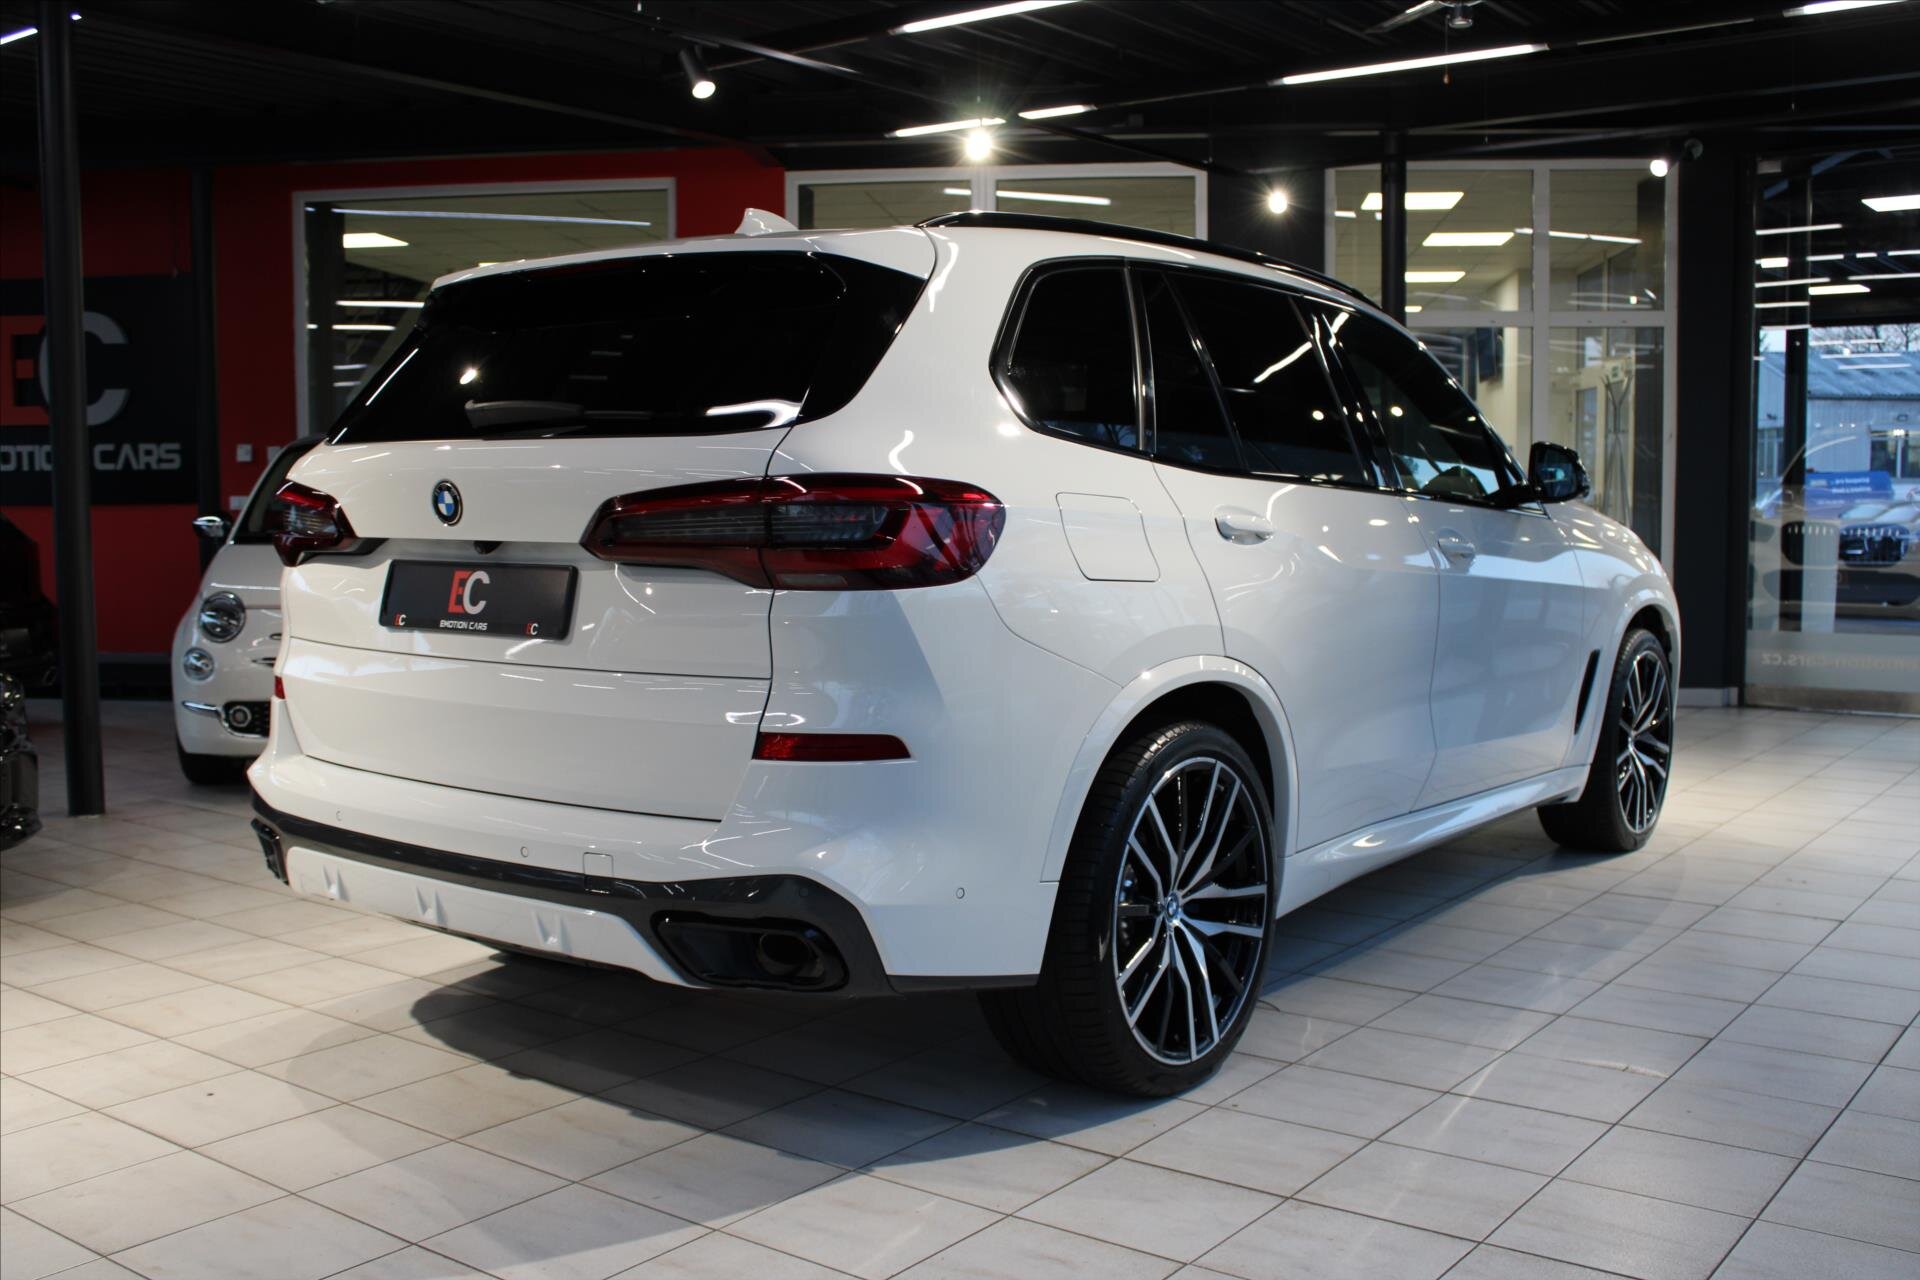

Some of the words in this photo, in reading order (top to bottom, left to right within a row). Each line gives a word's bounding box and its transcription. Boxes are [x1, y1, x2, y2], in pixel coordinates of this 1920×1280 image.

[93, 443, 182, 471] CARS
[448, 570, 490, 615] EC
[440, 620, 468, 629] EMOTION
[469, 622, 488, 631] CARS
